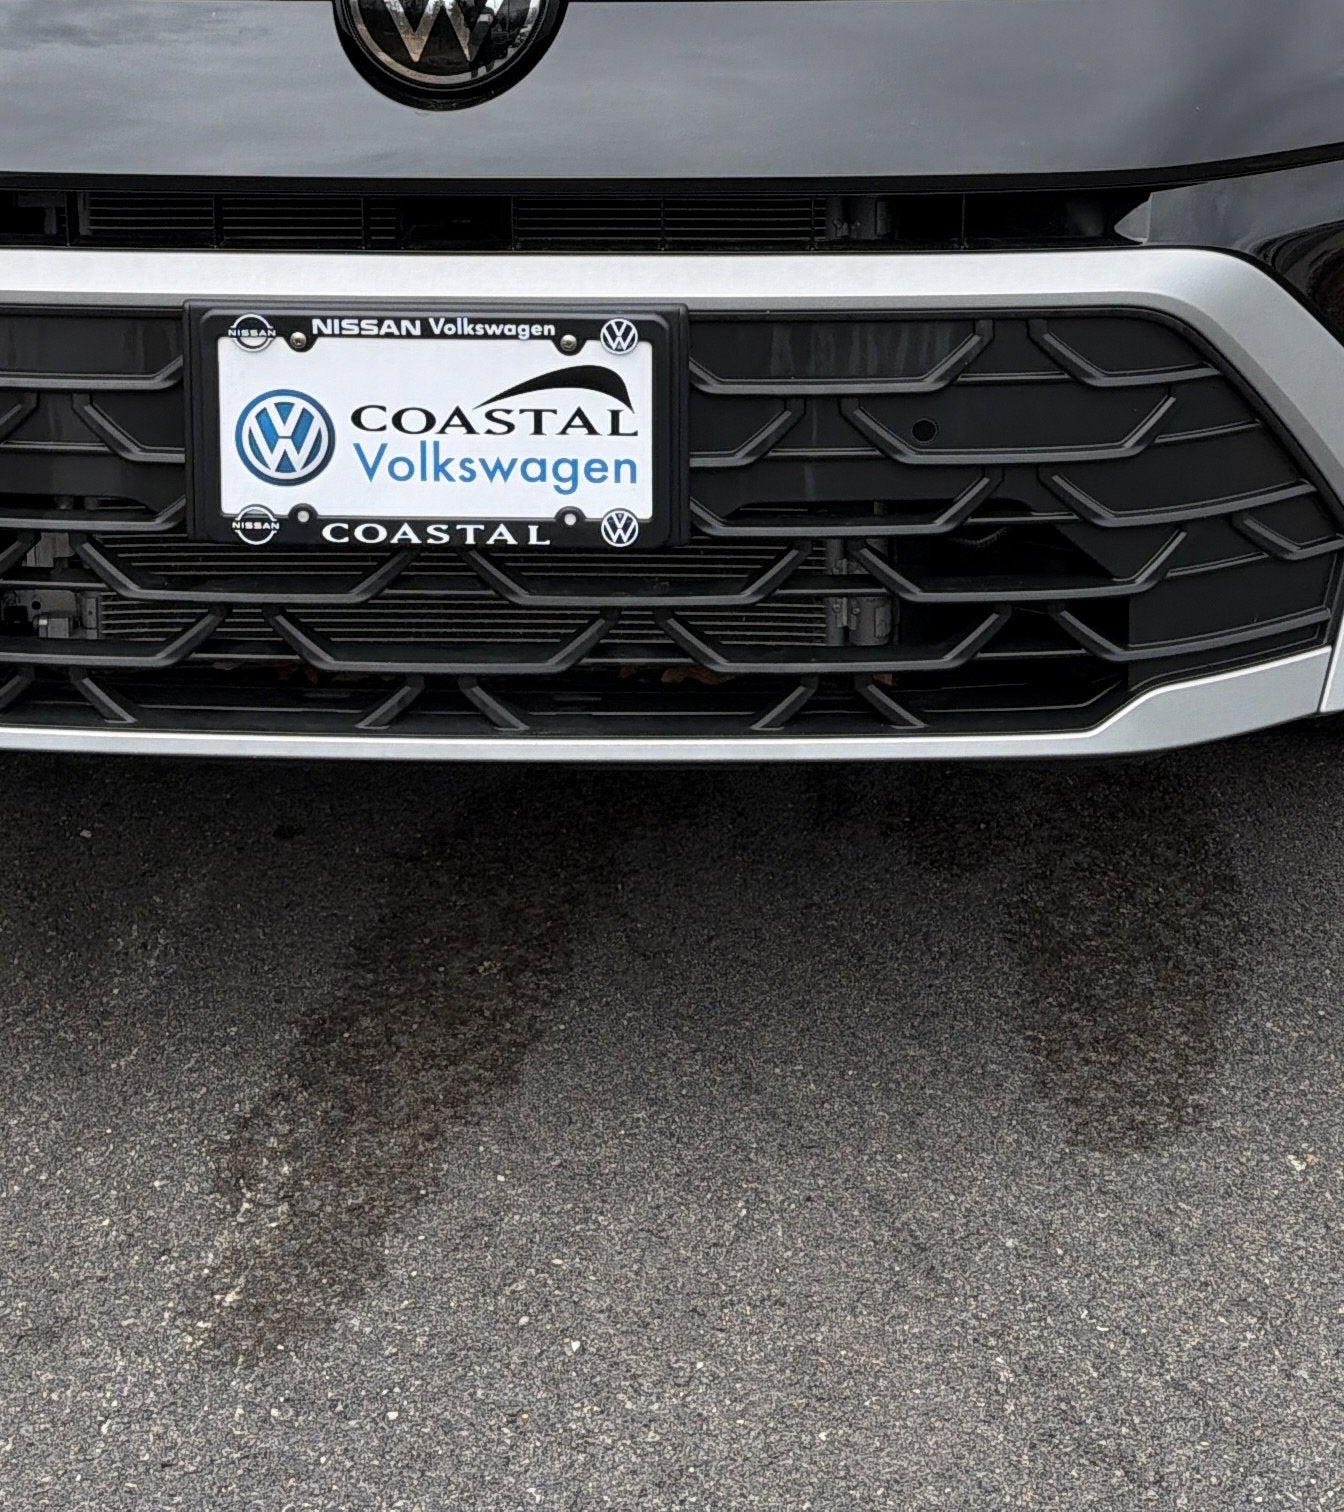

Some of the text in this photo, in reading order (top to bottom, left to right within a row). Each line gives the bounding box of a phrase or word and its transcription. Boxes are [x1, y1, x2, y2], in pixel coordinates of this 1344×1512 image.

[228, 328, 276, 337] NISSAN
[311, 316, 556, 339] NISSAN Volkswagen
[350, 404, 639, 437] COASTAL
[352, 440, 638, 495] Volkswagen
[231, 521, 280, 530] NISSAN
[321, 522, 551, 546] COASTAL
